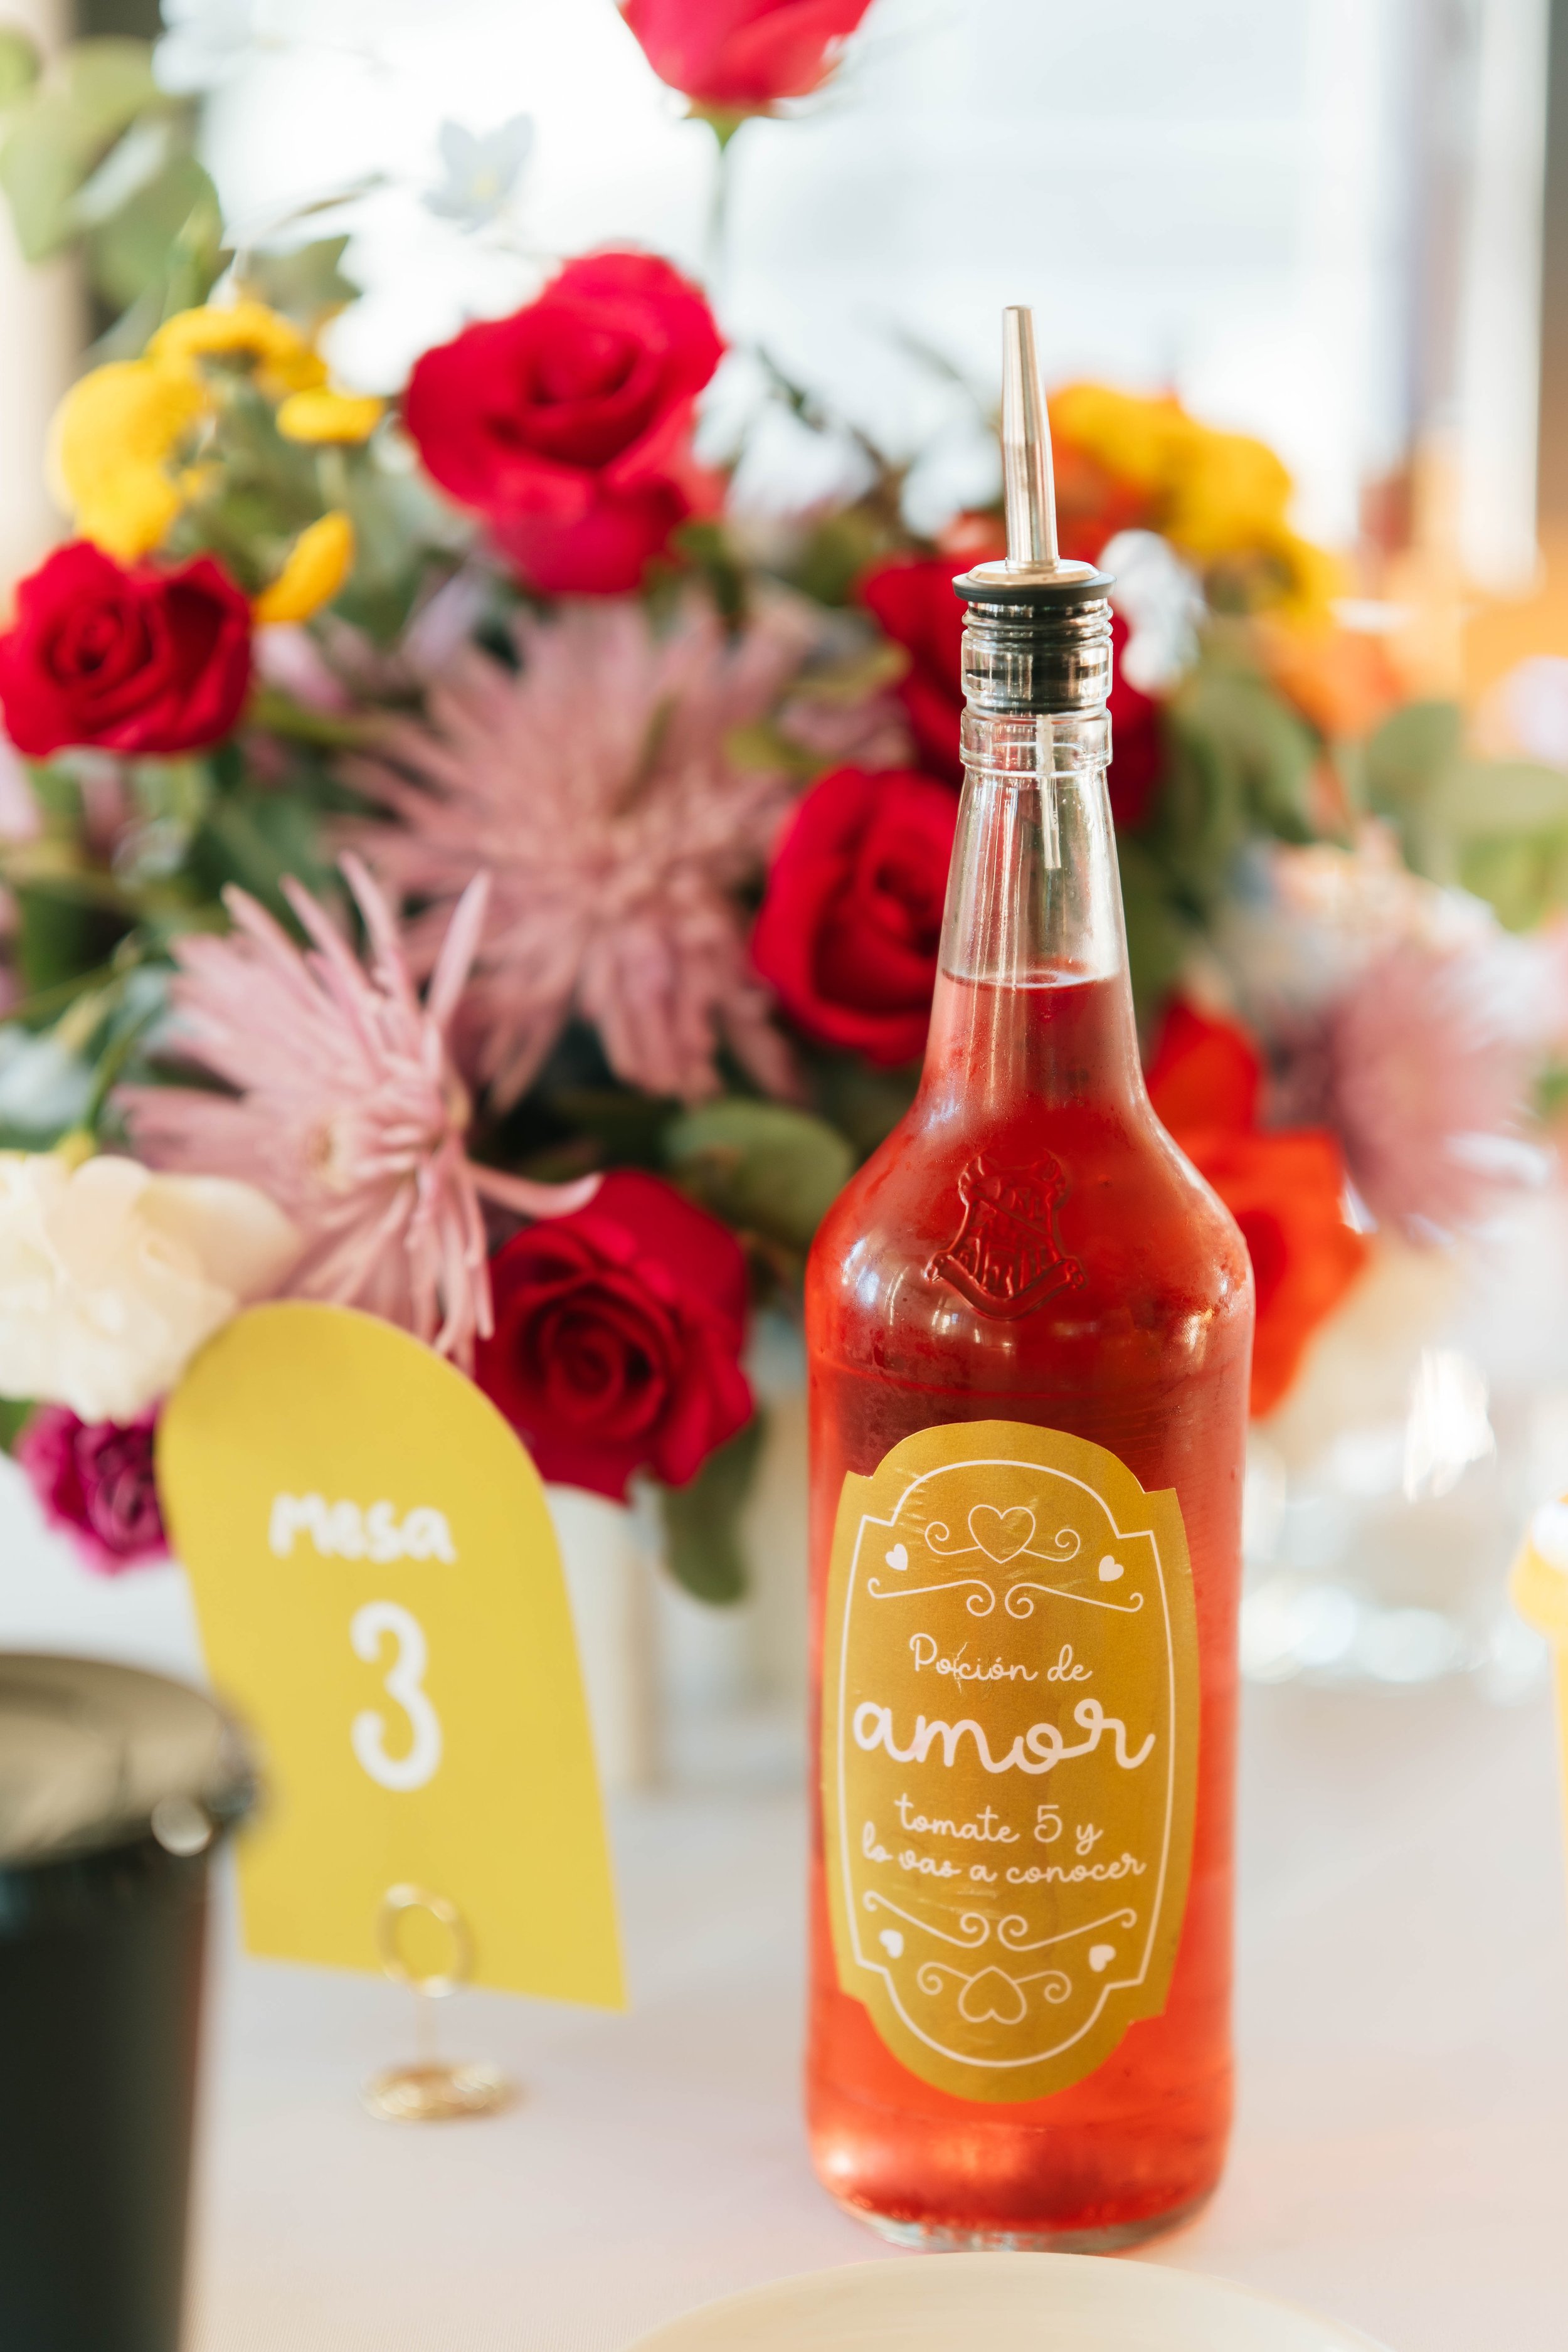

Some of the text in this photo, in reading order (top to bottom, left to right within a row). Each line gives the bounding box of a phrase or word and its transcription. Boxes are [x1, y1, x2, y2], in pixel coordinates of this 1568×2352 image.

[908, 1632, 1094, 1683] Poción de
[349, 1600, 443, 1793] 3
[853, 1697, 1156, 1776] amor
[861, 1820, 1147, 1884] lo vas a conocer
[894, 1793, 1104, 1857] tomate 5 y
